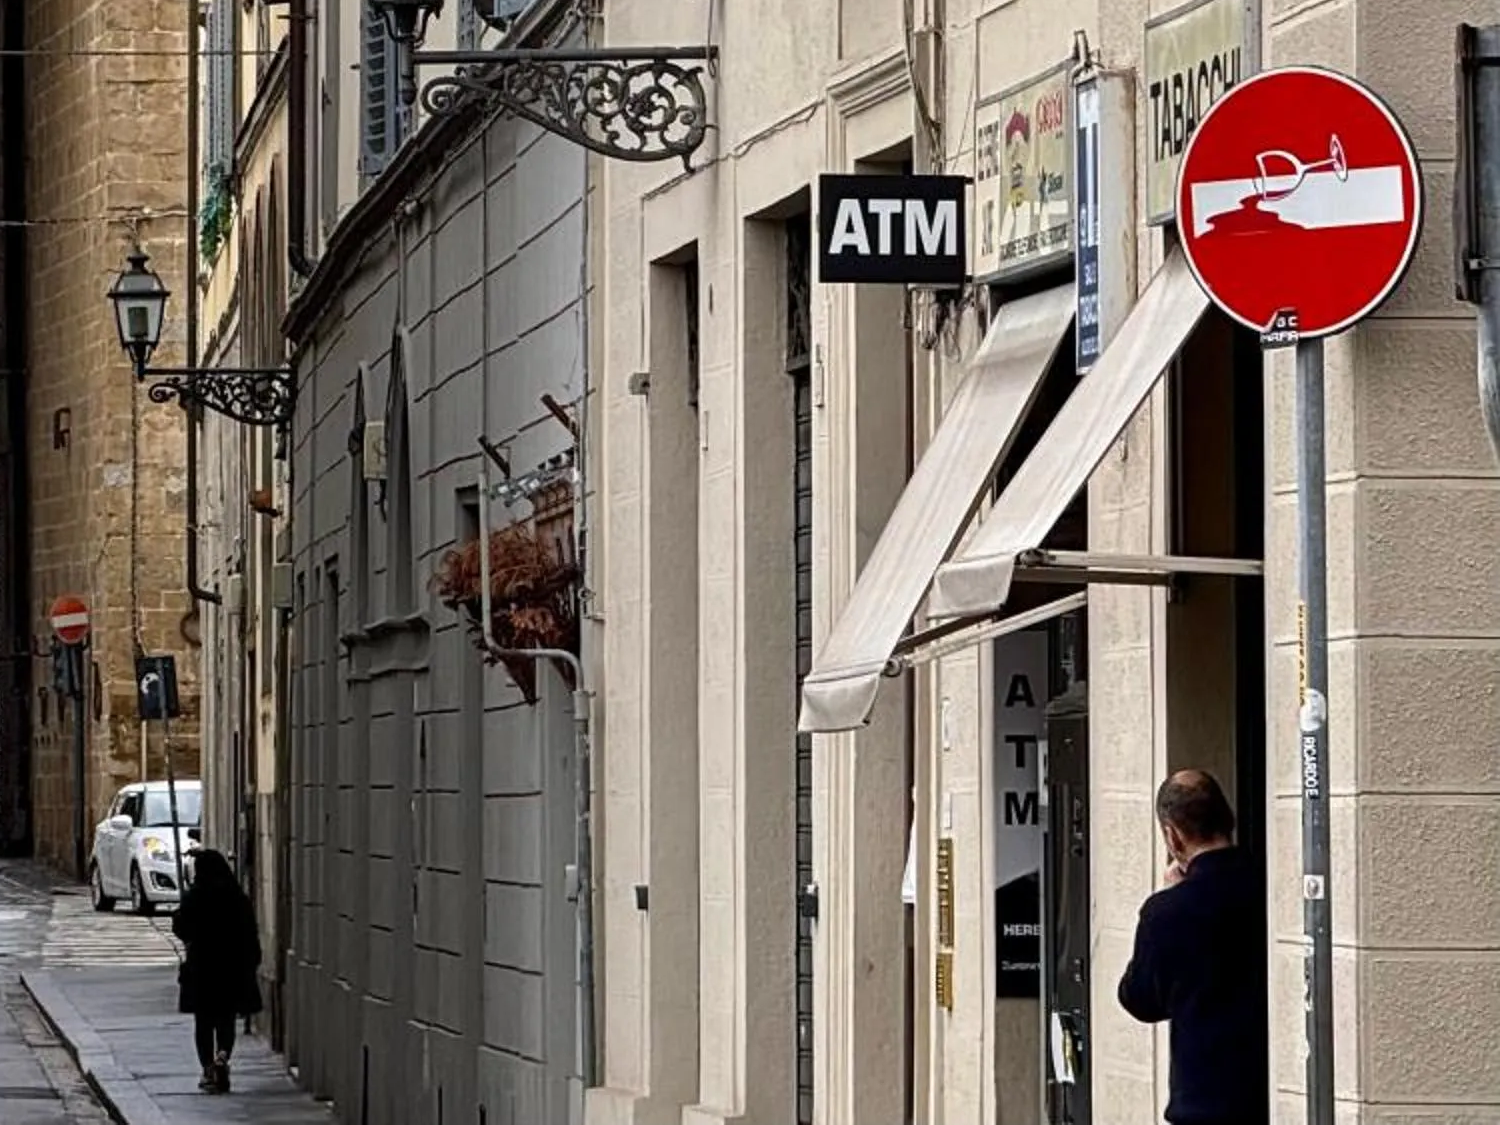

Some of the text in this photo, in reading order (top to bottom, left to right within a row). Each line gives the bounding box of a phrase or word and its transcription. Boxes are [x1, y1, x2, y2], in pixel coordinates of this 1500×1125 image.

[828, 198, 957, 256] ATM
[1004, 673, 1040, 826] ATM
[1003, 923, 1044, 936] HERE
